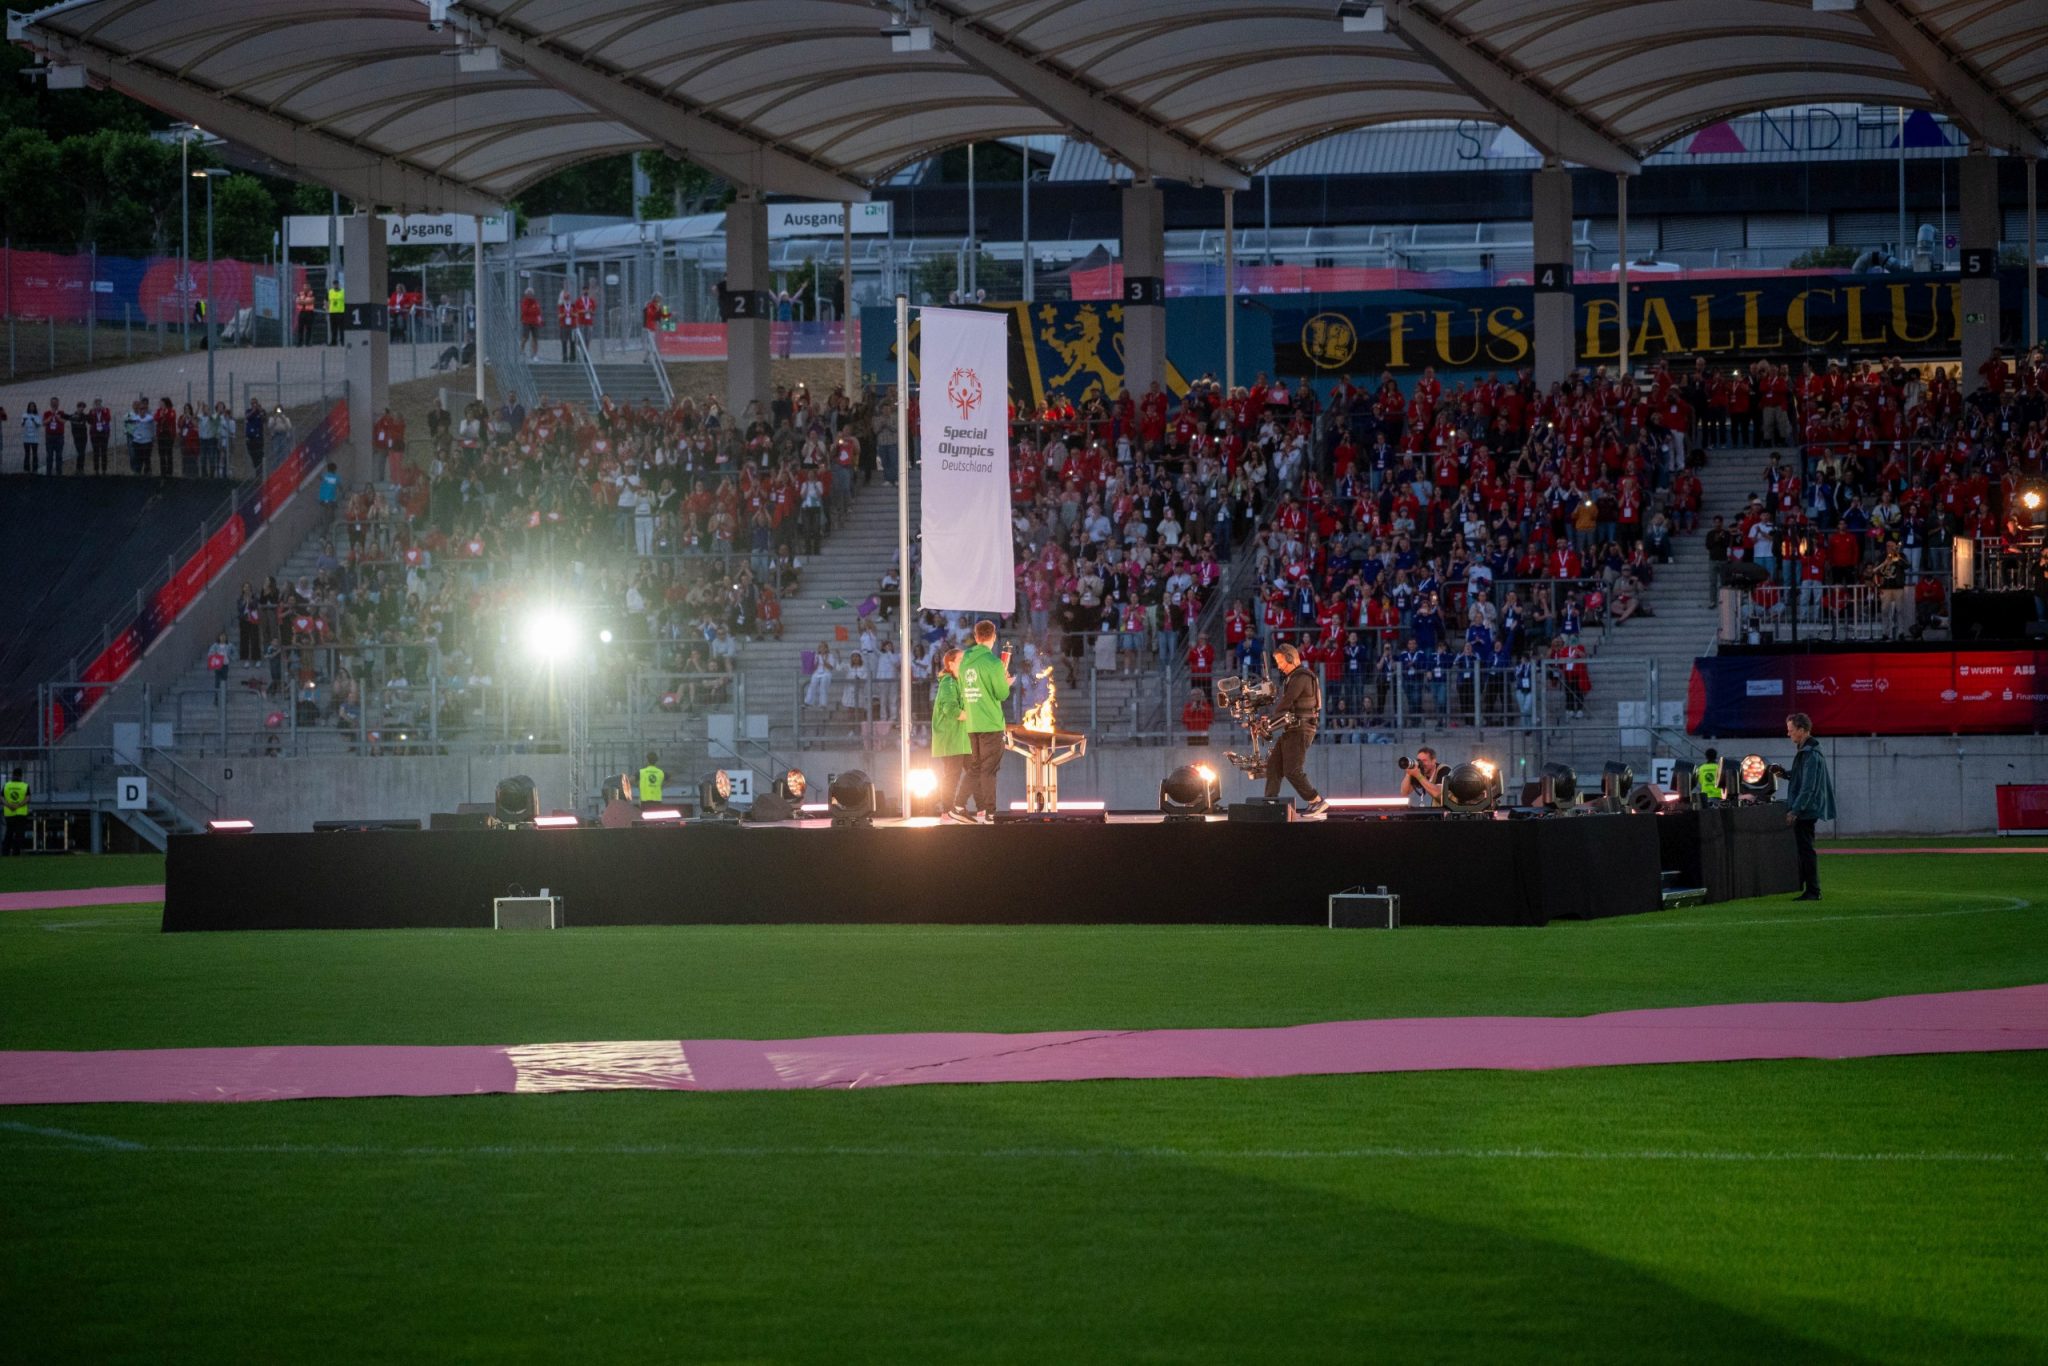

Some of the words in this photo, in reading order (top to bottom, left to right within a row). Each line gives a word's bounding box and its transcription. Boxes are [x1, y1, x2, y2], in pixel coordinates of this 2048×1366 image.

[1969, 255, 1981, 273] 5
[1541, 269, 1554, 287] 4
[1131, 282, 1143, 300] 3
[734, 296, 746, 313] 2
[352, 308, 361, 326] 1
[944, 426, 988, 440] Special
[938, 442, 995, 458] Olympics
[942, 459, 993, 473] Deutschland
[2013, 665, 2036, 676] ABB
[224, 768, 233, 780] D
[126, 785, 139, 801] D
